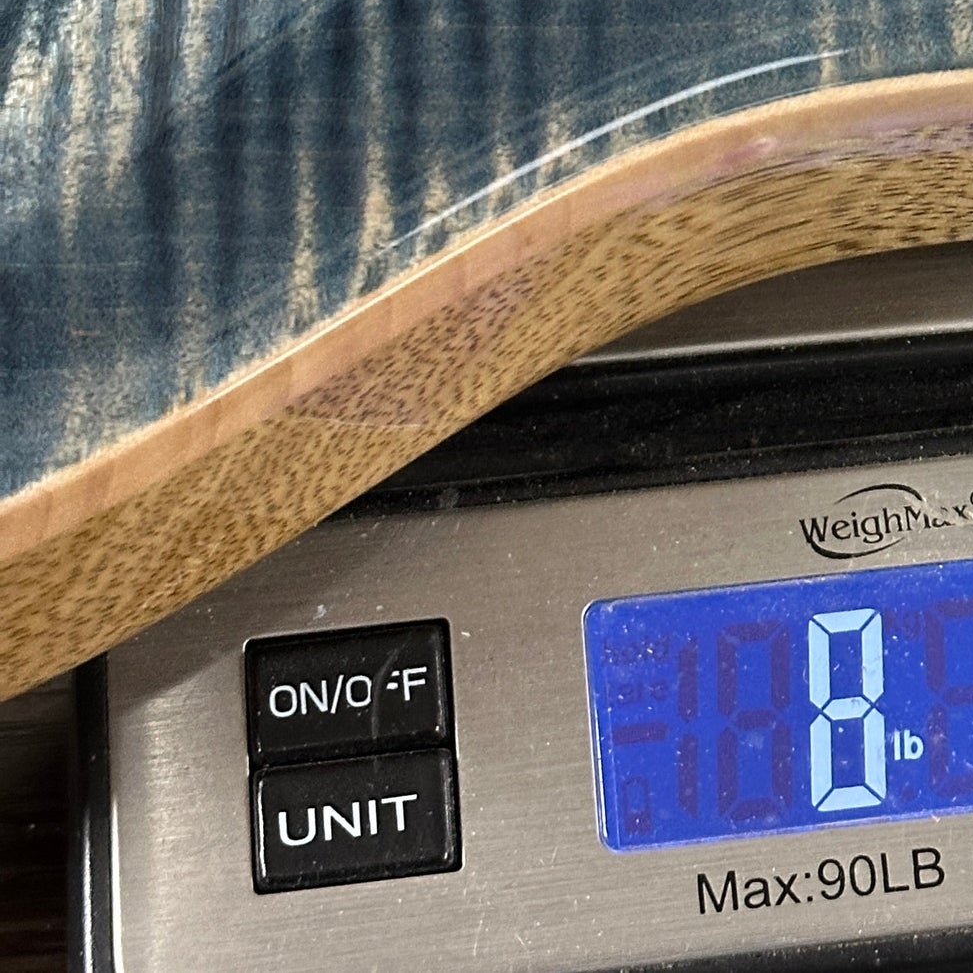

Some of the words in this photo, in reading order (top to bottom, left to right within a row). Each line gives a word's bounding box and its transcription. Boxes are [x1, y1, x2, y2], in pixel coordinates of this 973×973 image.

[268, 666, 428, 718] ON/OF
[808, 607, 888, 813] 8
[893, 729, 924, 761] lb
[277, 793, 418, 847] UNIT
[697, 847, 946, 915] Max:90LB
